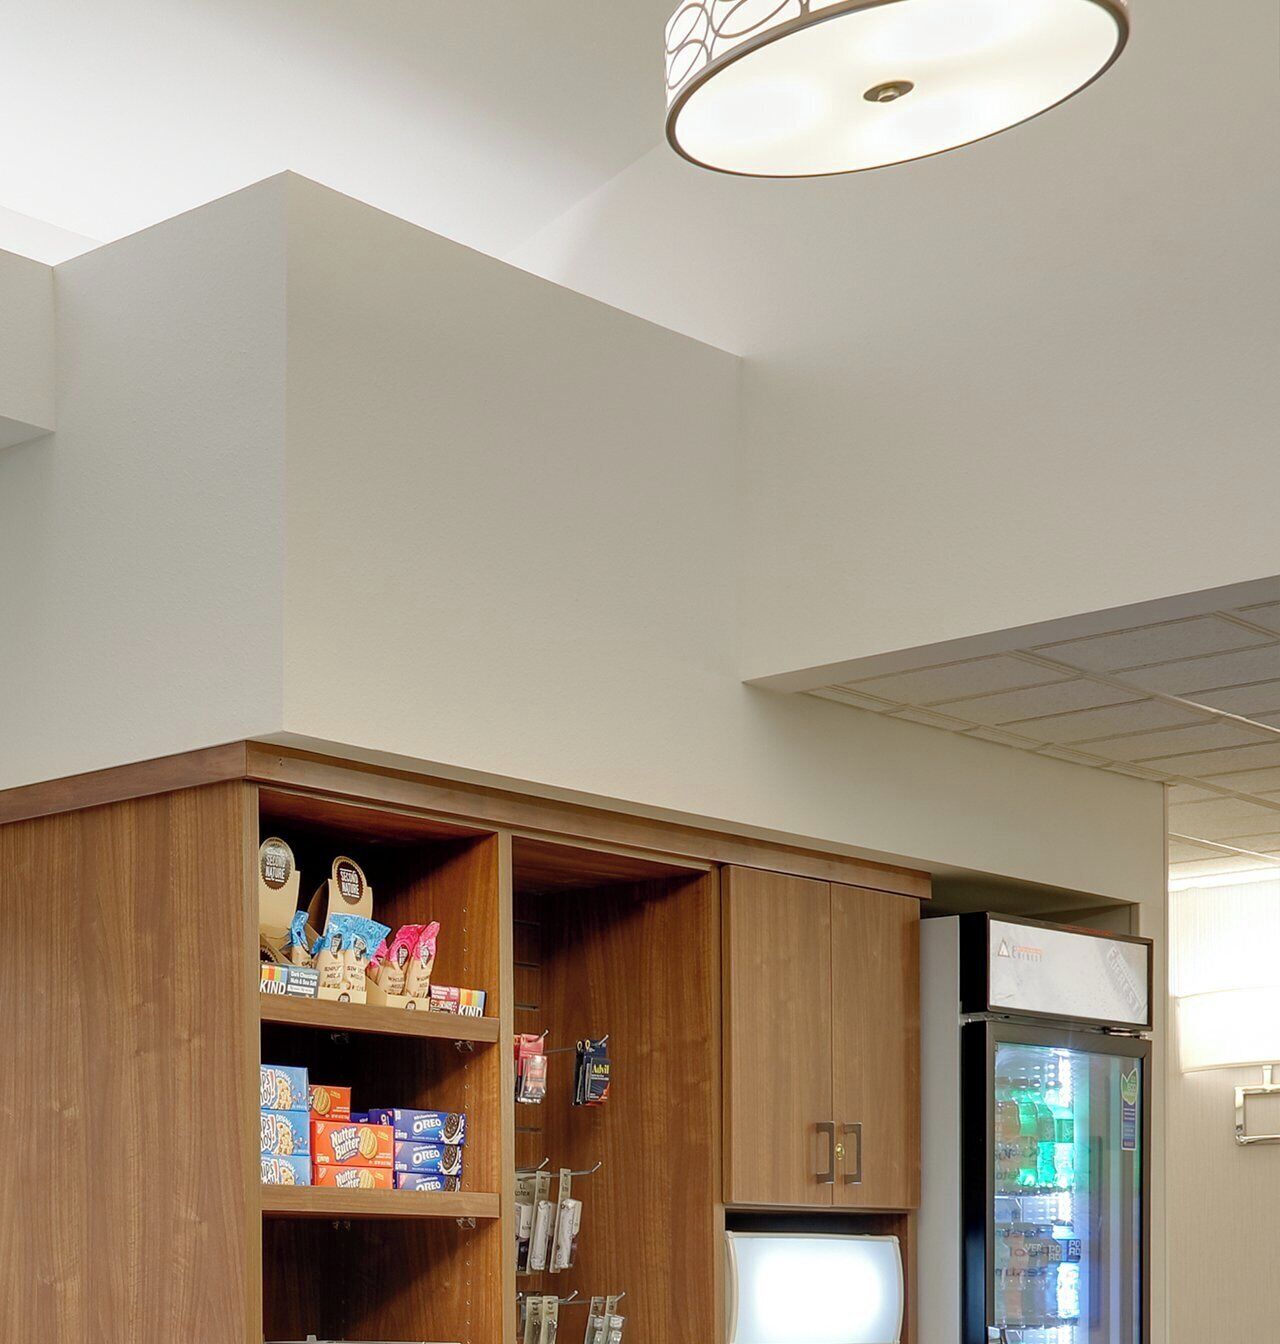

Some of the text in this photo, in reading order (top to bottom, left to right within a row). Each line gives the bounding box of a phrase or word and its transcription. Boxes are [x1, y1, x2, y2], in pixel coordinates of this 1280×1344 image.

[260, 980, 287, 995] KIND
[458, 1004, 484, 1018] KIND
[592, 1063, 610, 1075] Advil
[413, 1118, 442, 1134] OREO
[330, 1127, 357, 1149] Nutter
[334, 1138, 360, 1161] Butter
[412, 1149, 440, 1165] OREO
[335, 1169, 358, 1188] Nutter
[415, 1180, 441, 1191] OREO
